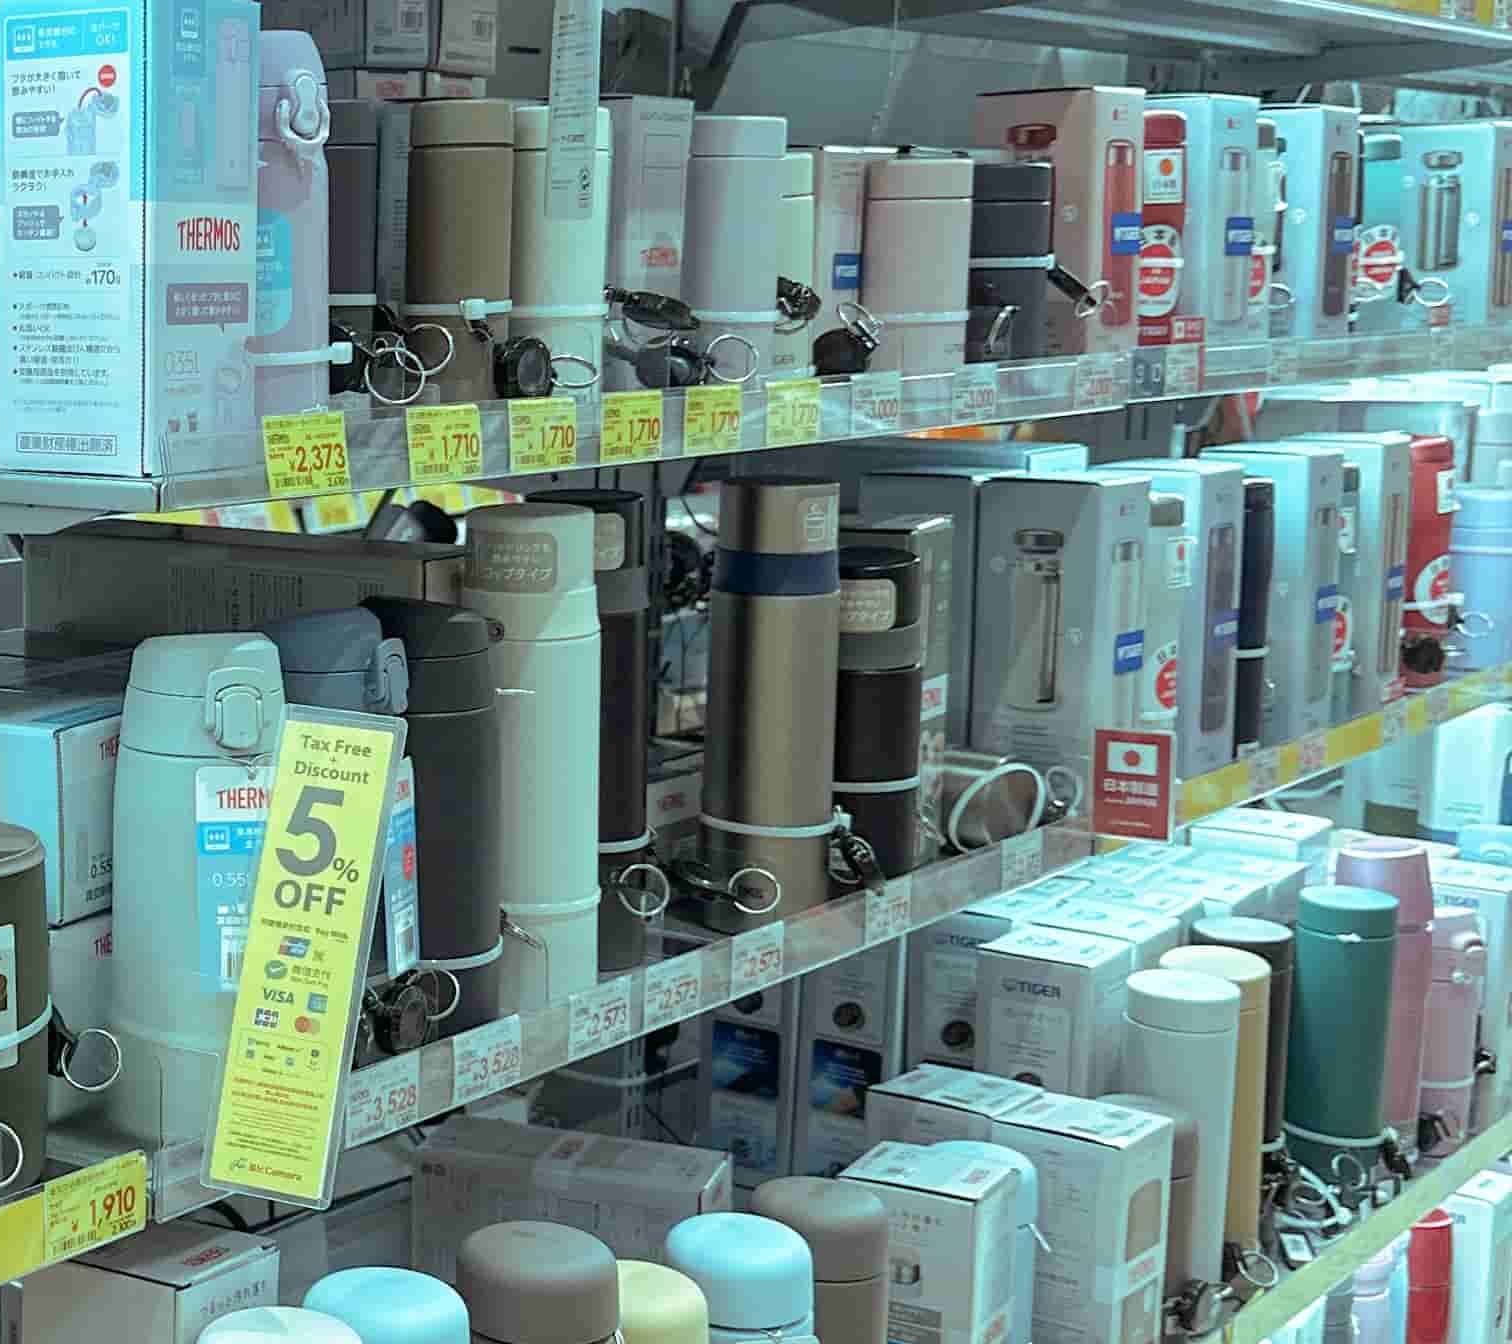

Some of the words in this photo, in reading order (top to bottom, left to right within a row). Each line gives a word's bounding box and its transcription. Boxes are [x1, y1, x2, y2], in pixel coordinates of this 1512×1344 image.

[176, 217, 241, 252] THERMOS
[441, 434, 480, 462] 1,710
[540, 424, 576, 454] 1,710
[295, 443, 346, 476] 2,373
[301, 734, 332, 754] Tax
[333, 739, 373, 759] Free
[293, 760, 370, 785] Discount
[216, 787, 269, 810] THERM
[273, 879, 347, 916] OFF
[262, 987, 296, 1005] VISA
[1018, 980, 1061, 1000] TIGER
[89, 1184, 136, 1229] 1,910
